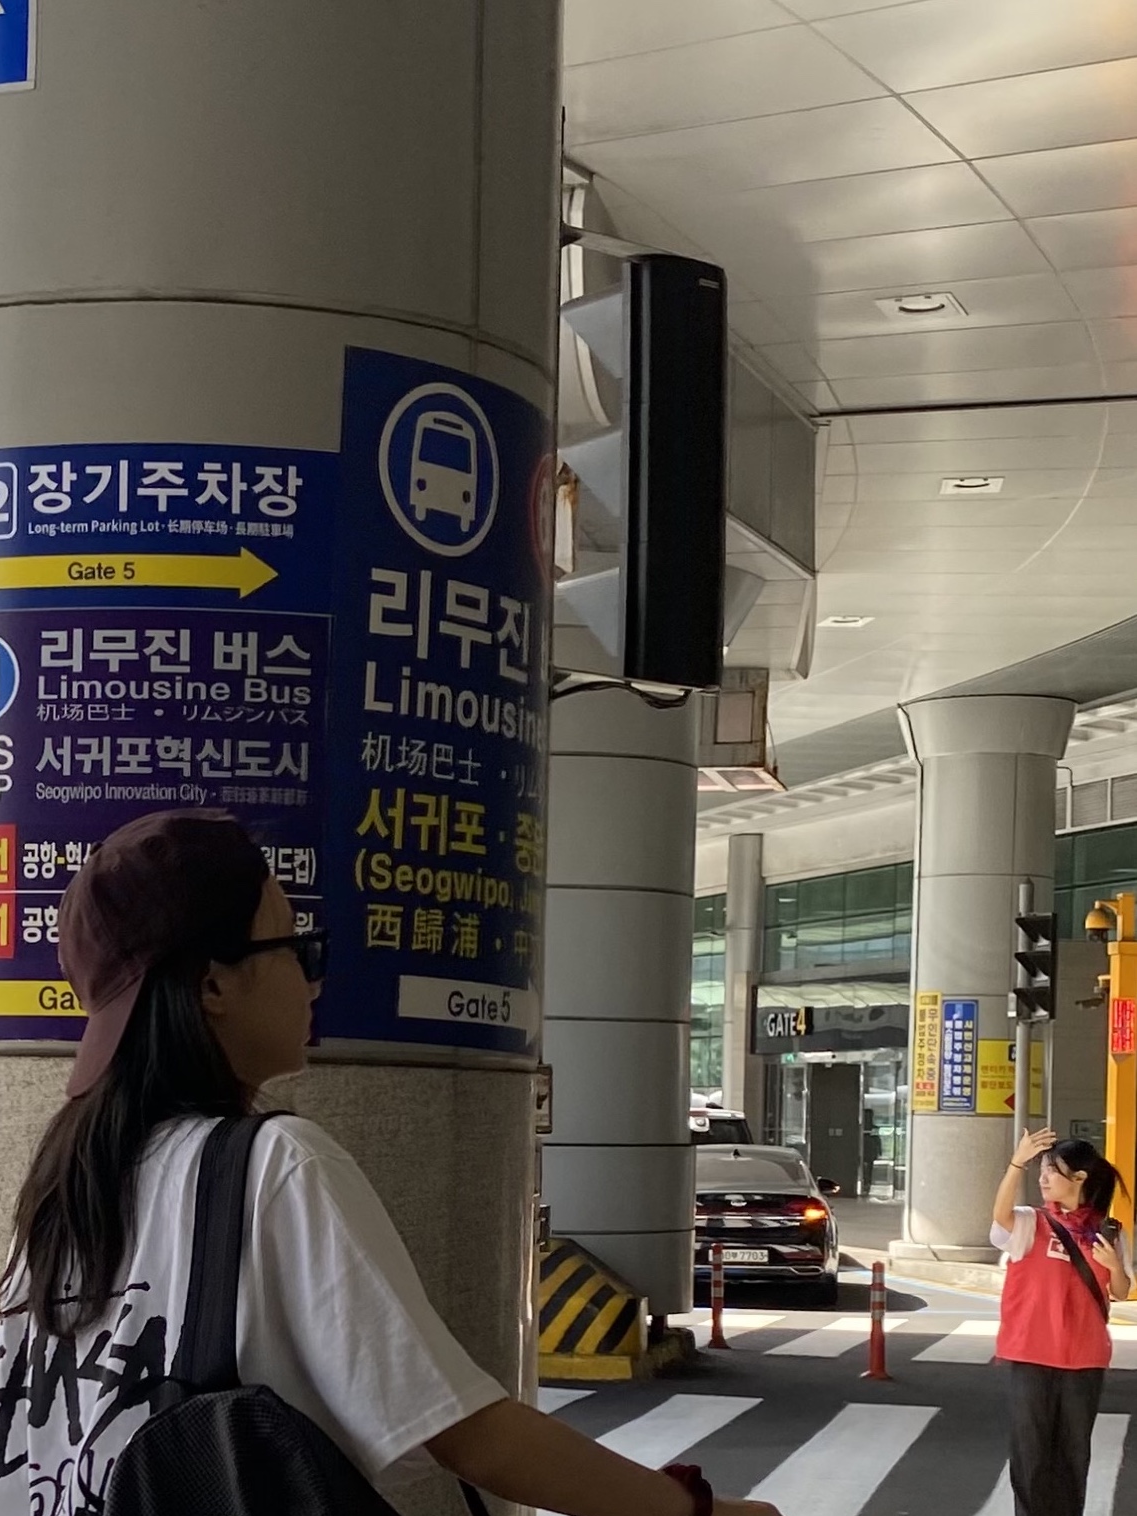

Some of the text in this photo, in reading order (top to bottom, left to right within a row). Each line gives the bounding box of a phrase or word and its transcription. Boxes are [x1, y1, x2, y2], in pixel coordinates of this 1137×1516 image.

[27, 460, 303, 517] 장기주차장
[28, 521, 89, 535] Long-term
[91, 519, 138, 535] Parking
[140, 519, 160, 533] Lot
[68, 562, 136, 581] Gate 5
[369, 567, 528, 684] 리무진
[40, 627, 312, 676] 리무진 버스
[37, 675, 312, 705] Limousine Bus
[36, 702, 310, 726] 机场巴士 リムジンバス
[35, 736, 309, 782] 서귀포혁신도시
[362, 731, 482, 786] 机场巴士
[35, 782, 103, 804] Seogwipo
[105, 784, 179, 803] Innovation
[181, 785, 208, 805] City
[356, 788, 487, 856] 서귀포
[448, 990, 511, 1022] Gate 5
[766, 1006, 807, 1037] GATE 4
